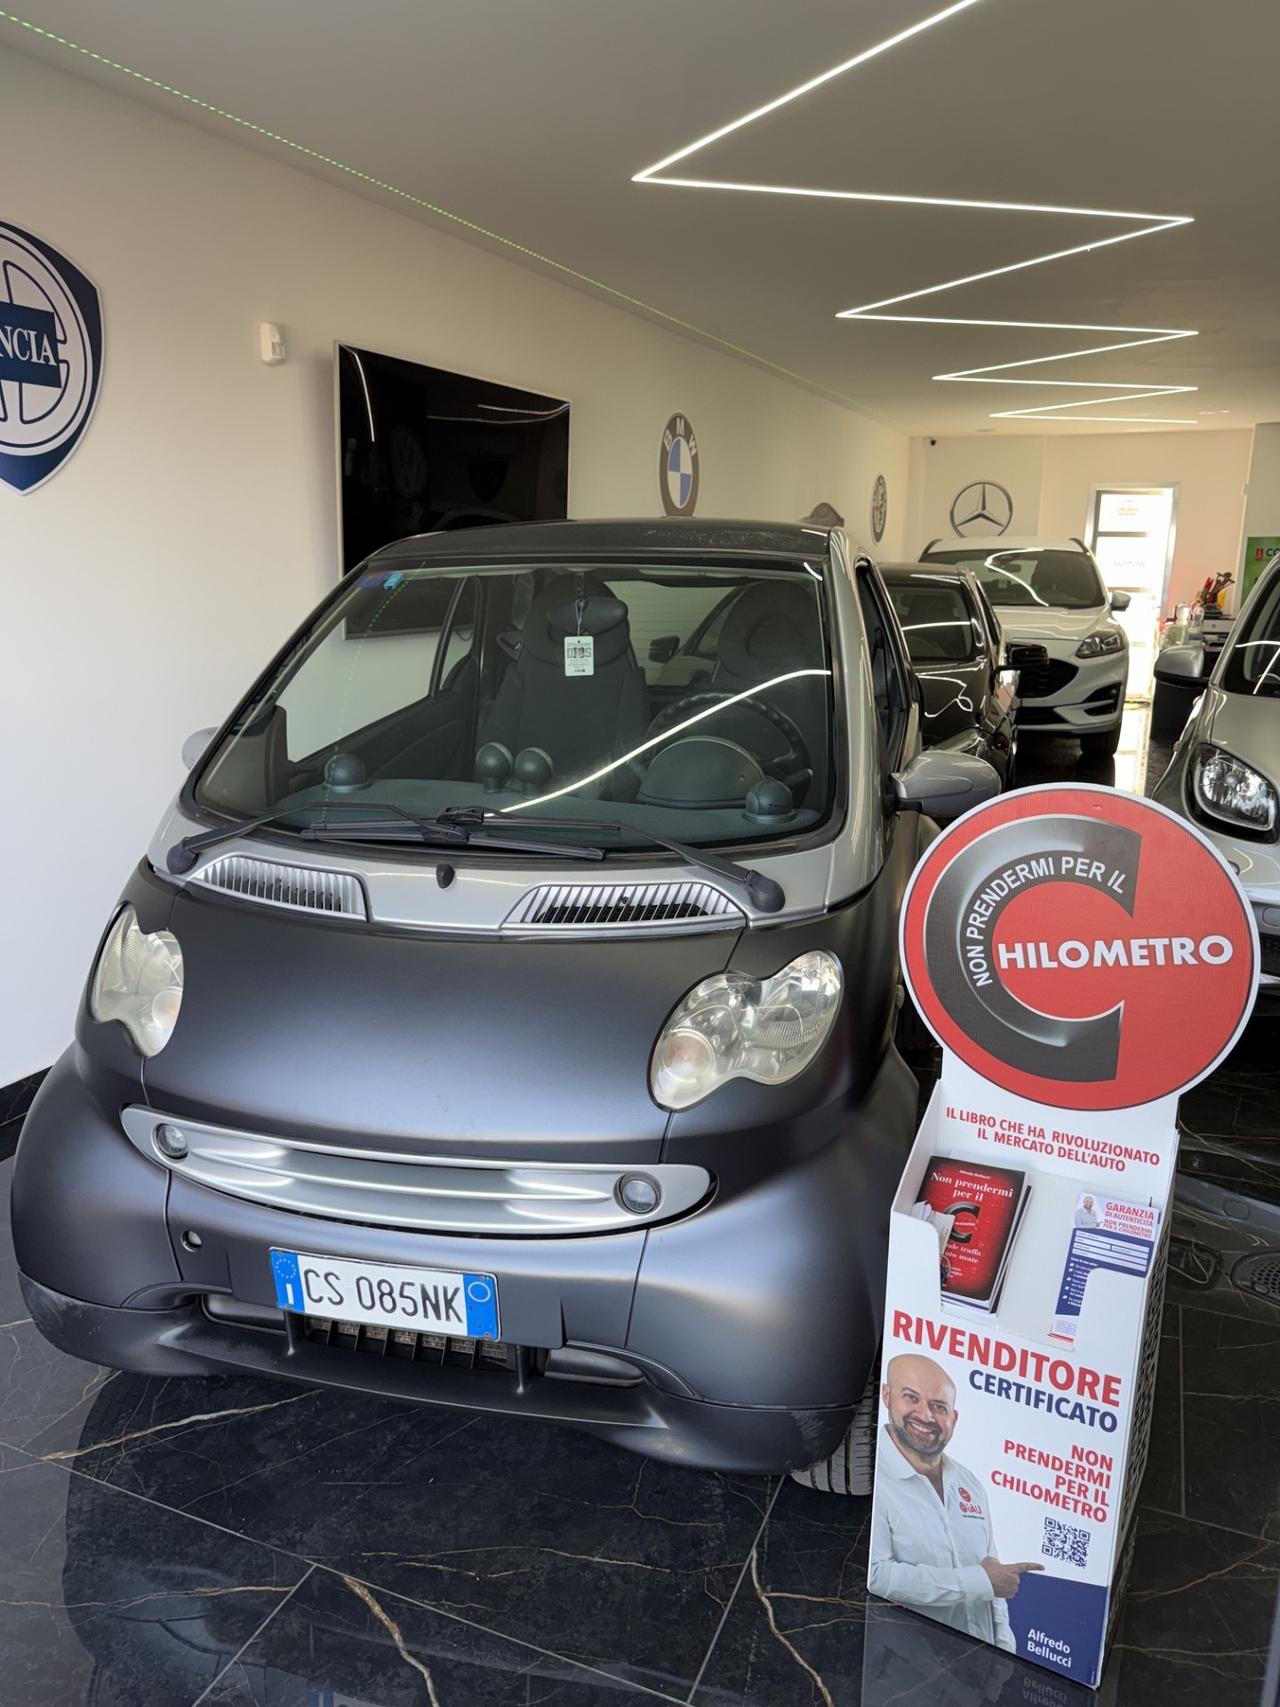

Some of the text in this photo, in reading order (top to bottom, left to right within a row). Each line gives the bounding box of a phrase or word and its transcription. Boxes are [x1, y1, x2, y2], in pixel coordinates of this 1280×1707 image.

[663, 417, 697, 457] BMW
[966, 856, 1127, 987] NON PRENDERMI PER IL
[998, 935, 1234, 969] HILOMETRO
[946, 1107, 1160, 1166] IL LIBRO CHE HA RIVOLUZIONATO
[977, 1128, 1126, 1172] IL MERCATO DELL'AUTO
[931, 1172, 1013, 1198] Non prendermi
[952, 1189, 984, 1202] per il
[1105, 1218, 1117, 1226] NON
[1106, 1202, 1154, 1220] GARANZIA
[286, 1283, 294, 1305] I
[304, 1268, 463, 1324] CS 085NK
[892, 1309, 1122, 1408] RIVENDITORE
[969, 1369, 1118, 1433] CERTIFICATO
[1004, 1439, 1111, 1489] PRENDERMI
[1071, 1445, 1113, 1472] NON
[990, 1470, 1107, 1523] CHILOMETRO
[1055, 1475, 1110, 1507] PER IL
[1027, 1640, 1072, 1668] Bellucci
[1028, 1628, 1071, 1654] Alfredo
